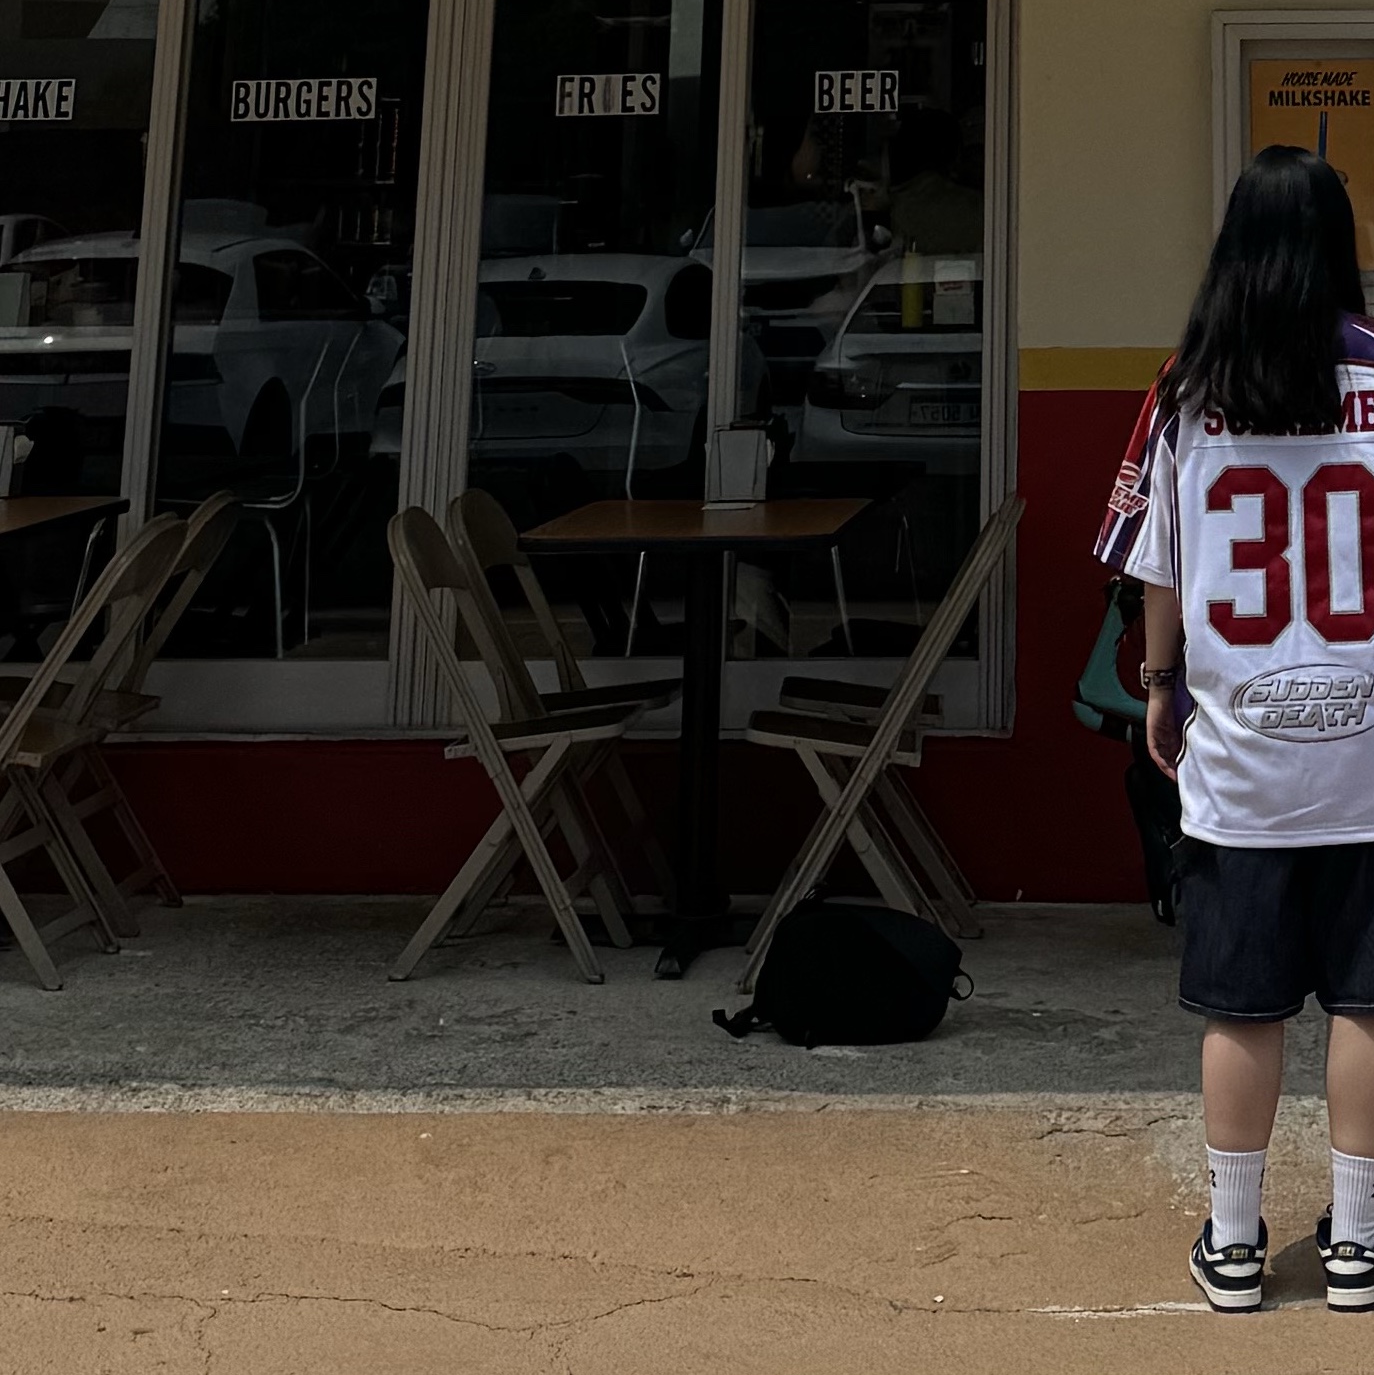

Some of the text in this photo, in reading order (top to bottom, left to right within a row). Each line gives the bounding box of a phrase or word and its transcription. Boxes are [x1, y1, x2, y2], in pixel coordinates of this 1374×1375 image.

[817, 72, 898, 112] BEER
[1281, 71, 1358, 87] HOUSE MADE
[232, 79, 374, 120] BURGERS
[1268, 90, 1371, 107] MILKSHAKE
[1259, 701, 1367, 732] DEATH
